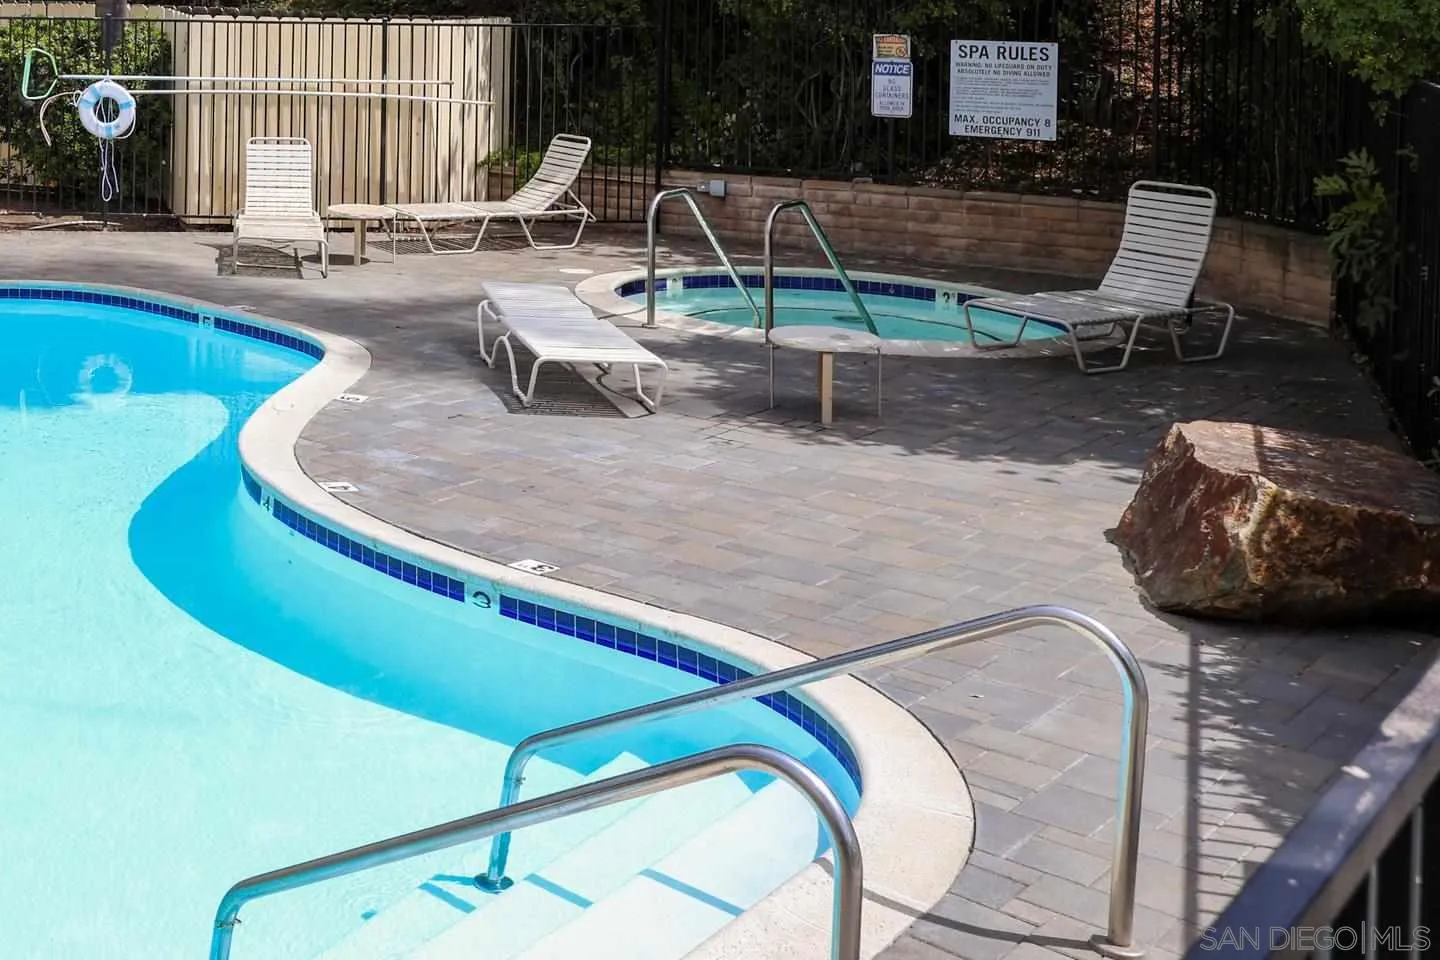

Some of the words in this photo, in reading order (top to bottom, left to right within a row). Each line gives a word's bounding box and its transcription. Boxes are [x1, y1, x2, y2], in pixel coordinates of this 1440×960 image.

[958, 44, 989, 59] SPA
[997, 46, 1049, 61] RULES
[875, 63, 910, 74] NOTICE
[954, 114, 979, 124] MAX.
[982, 115, 1041, 127] OCCUPANCY
[1044, 119, 1051, 128] 8
[964, 124, 1022, 137] EMERGENCY
[1026, 128, 1040, 137] 911
